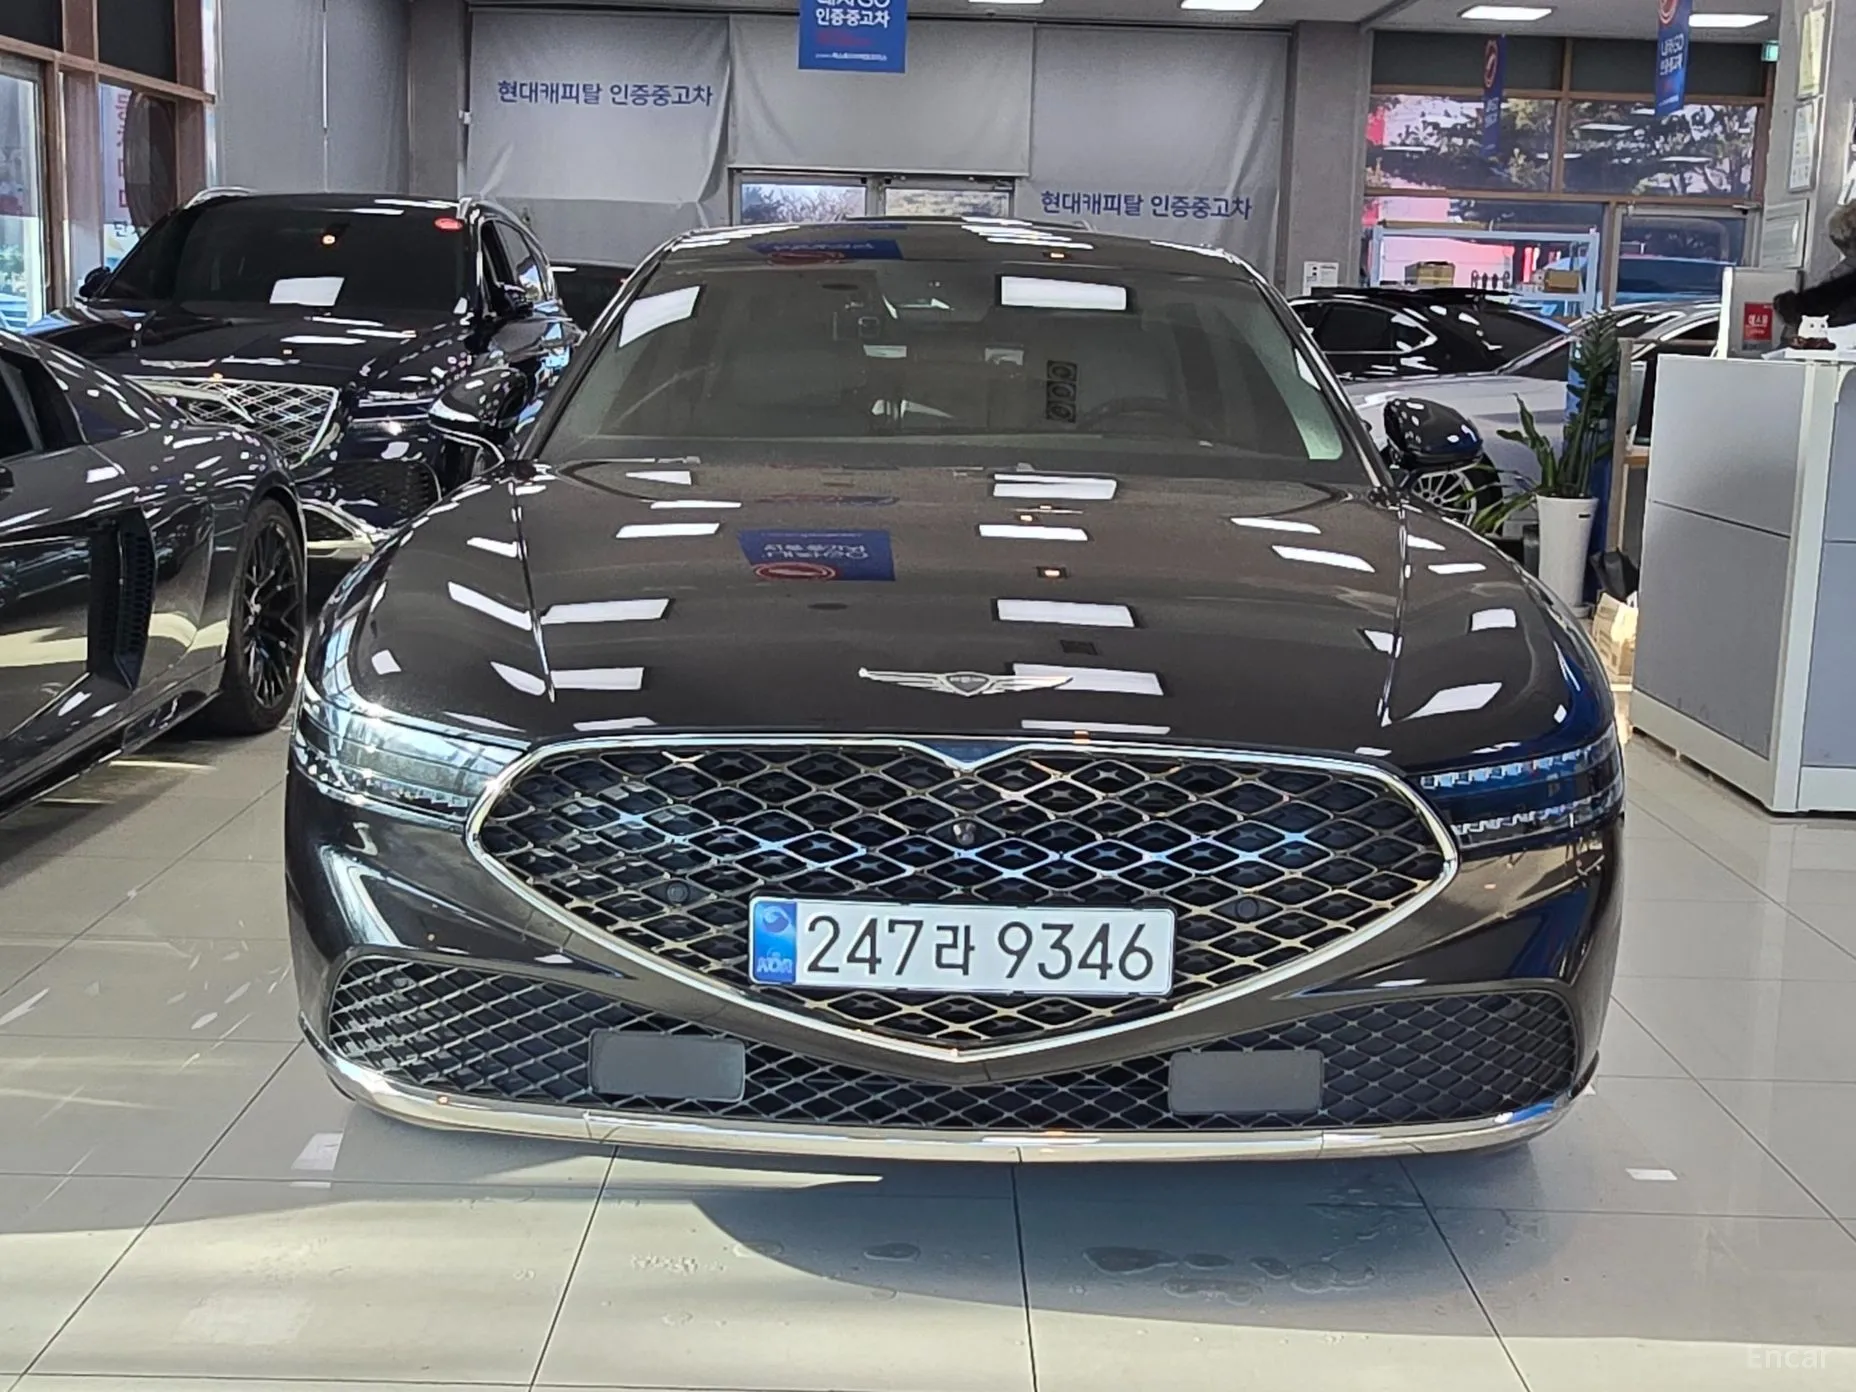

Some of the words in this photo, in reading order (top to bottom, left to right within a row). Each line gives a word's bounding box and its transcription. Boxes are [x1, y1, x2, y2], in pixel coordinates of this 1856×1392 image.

[815, 8, 891, 28] 인증중고차
[497, 79, 603, 105] 현대캐피탈
[609, 83, 714, 107] 인증중고차
[1040, 190, 1145, 217] 현대캐피탈
[1150, 194, 1252, 220] 인증중고차
[806, 914, 975, 976] 247라
[998, 921, 1154, 982] 9346
